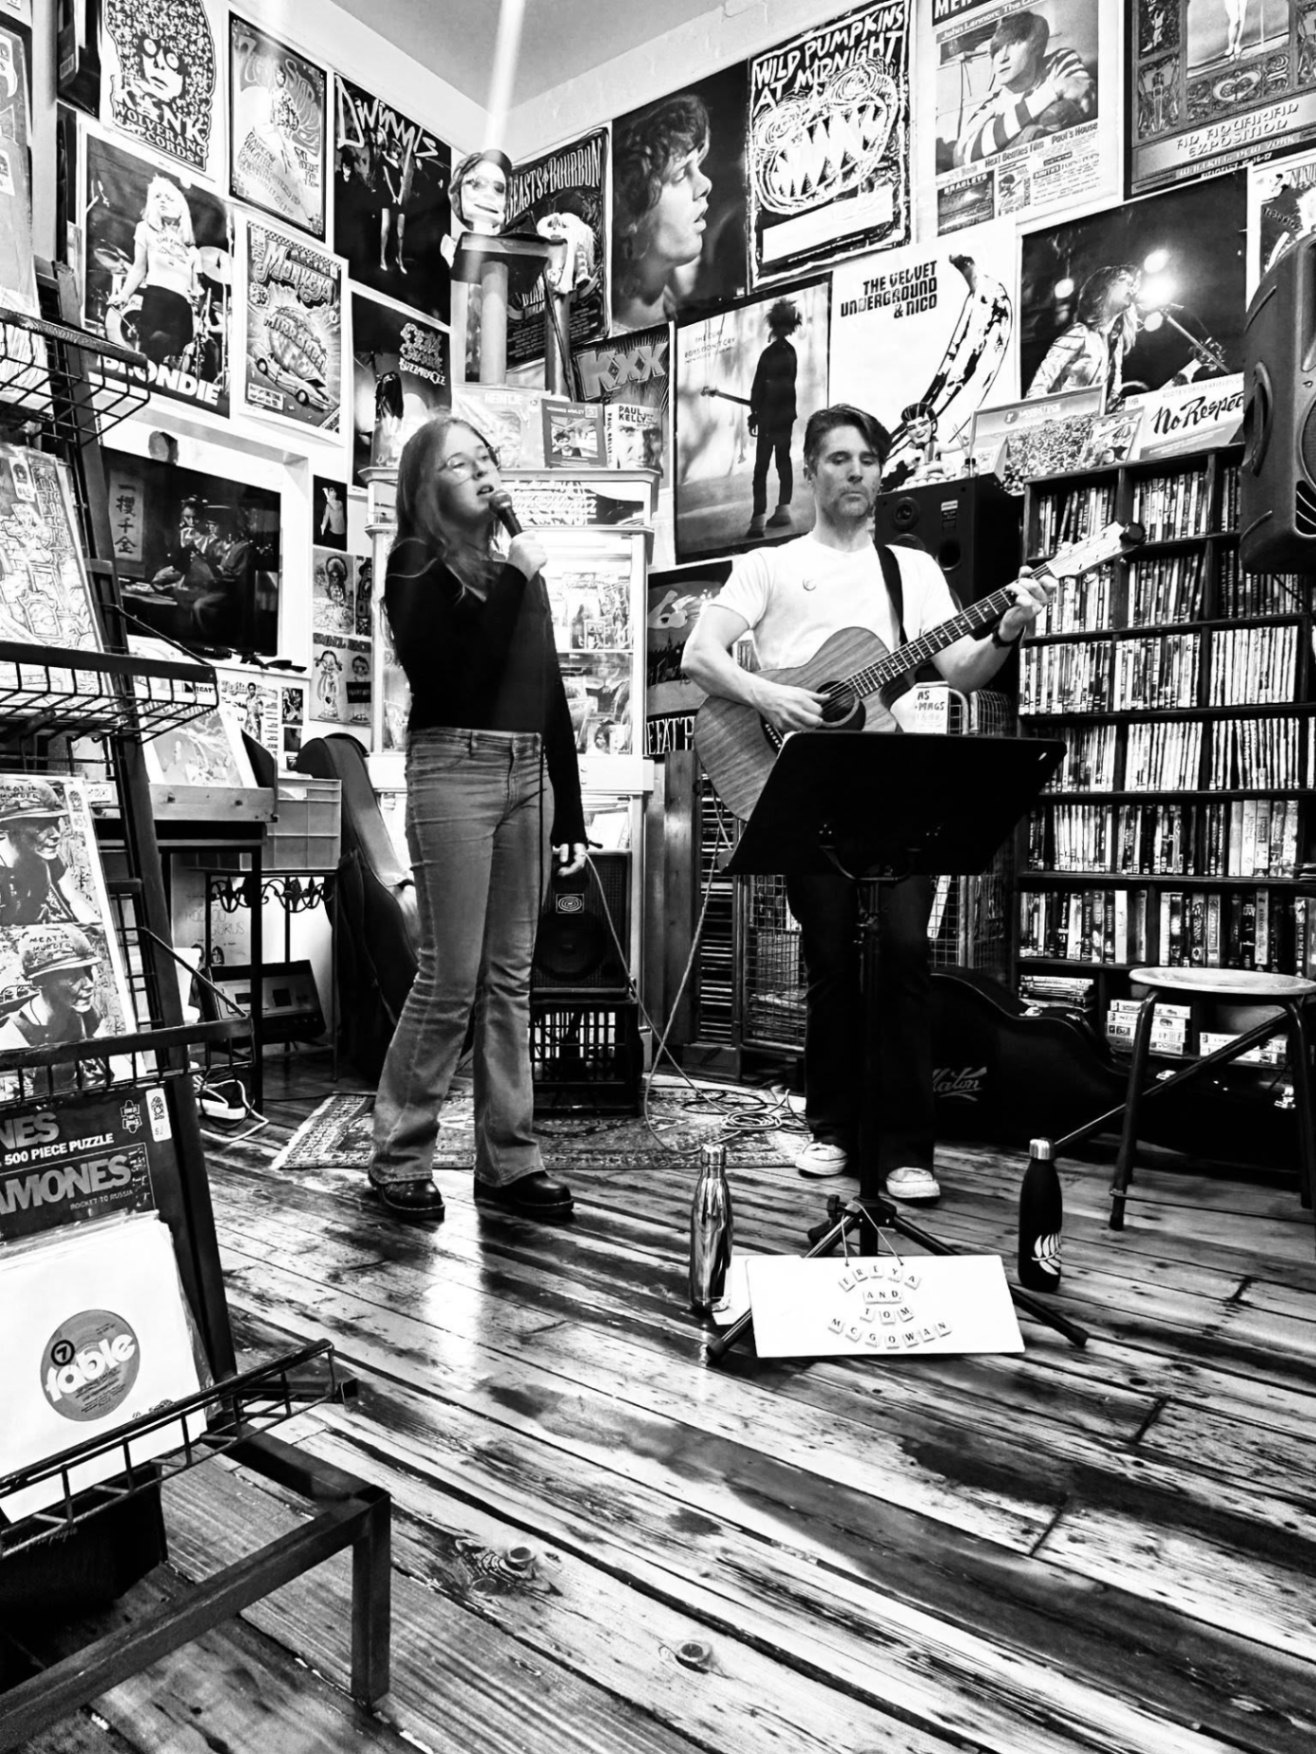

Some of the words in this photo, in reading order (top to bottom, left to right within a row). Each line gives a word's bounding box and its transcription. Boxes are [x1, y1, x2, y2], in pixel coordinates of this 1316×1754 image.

[941, 24, 964, 41] John
[755, 50, 801, 90] WILD
[804, 3, 905, 67] PUMPKINS
[752, 79, 788, 118] AT
[794, 31, 904, 95] MIDNIGHT
[114, 101, 208, 158] WOLVERANG
[1051, 130, 1074, 145] Paul's
[1075, 122, 1098, 137] House
[1188, 120, 1289, 158] EXPOSITION
[548, 137, 603, 194] BOURBON
[1002, 145, 1029, 163] Beatles
[863, 276, 887, 296] THE
[889, 260, 938, 288] VELVET
[840, 276, 938, 318] UNDERGROUND
[893, 303, 904, 320] &
[906, 293, 938, 317] NICO
[618, 405, 644, 416] PAUL
[618, 413, 647, 424] KELLY
[1150, 406, 1181, 435] No
[1180, 390, 1244, 429] Respec
[4, 1150, 29, 1166] 500
[30, 1143, 68, 1161] PIECE
[68, 1133, 115, 1153] PUZZLE
[0, 1154, 132, 1216] MONES
[69, 1197, 98, 1211] ROCKET
[99, 1195, 109, 1204] TO
[109, 1188, 134, 1202] RUSSIA
[842, 1265, 916, 1286] FREYA
[866, 1289, 899, 1300] AND
[865, 1306, 911, 1319] TOM
[831, 1317, 947, 1344] MCGOWAN
[55, 1344, 69, 1362] 7
